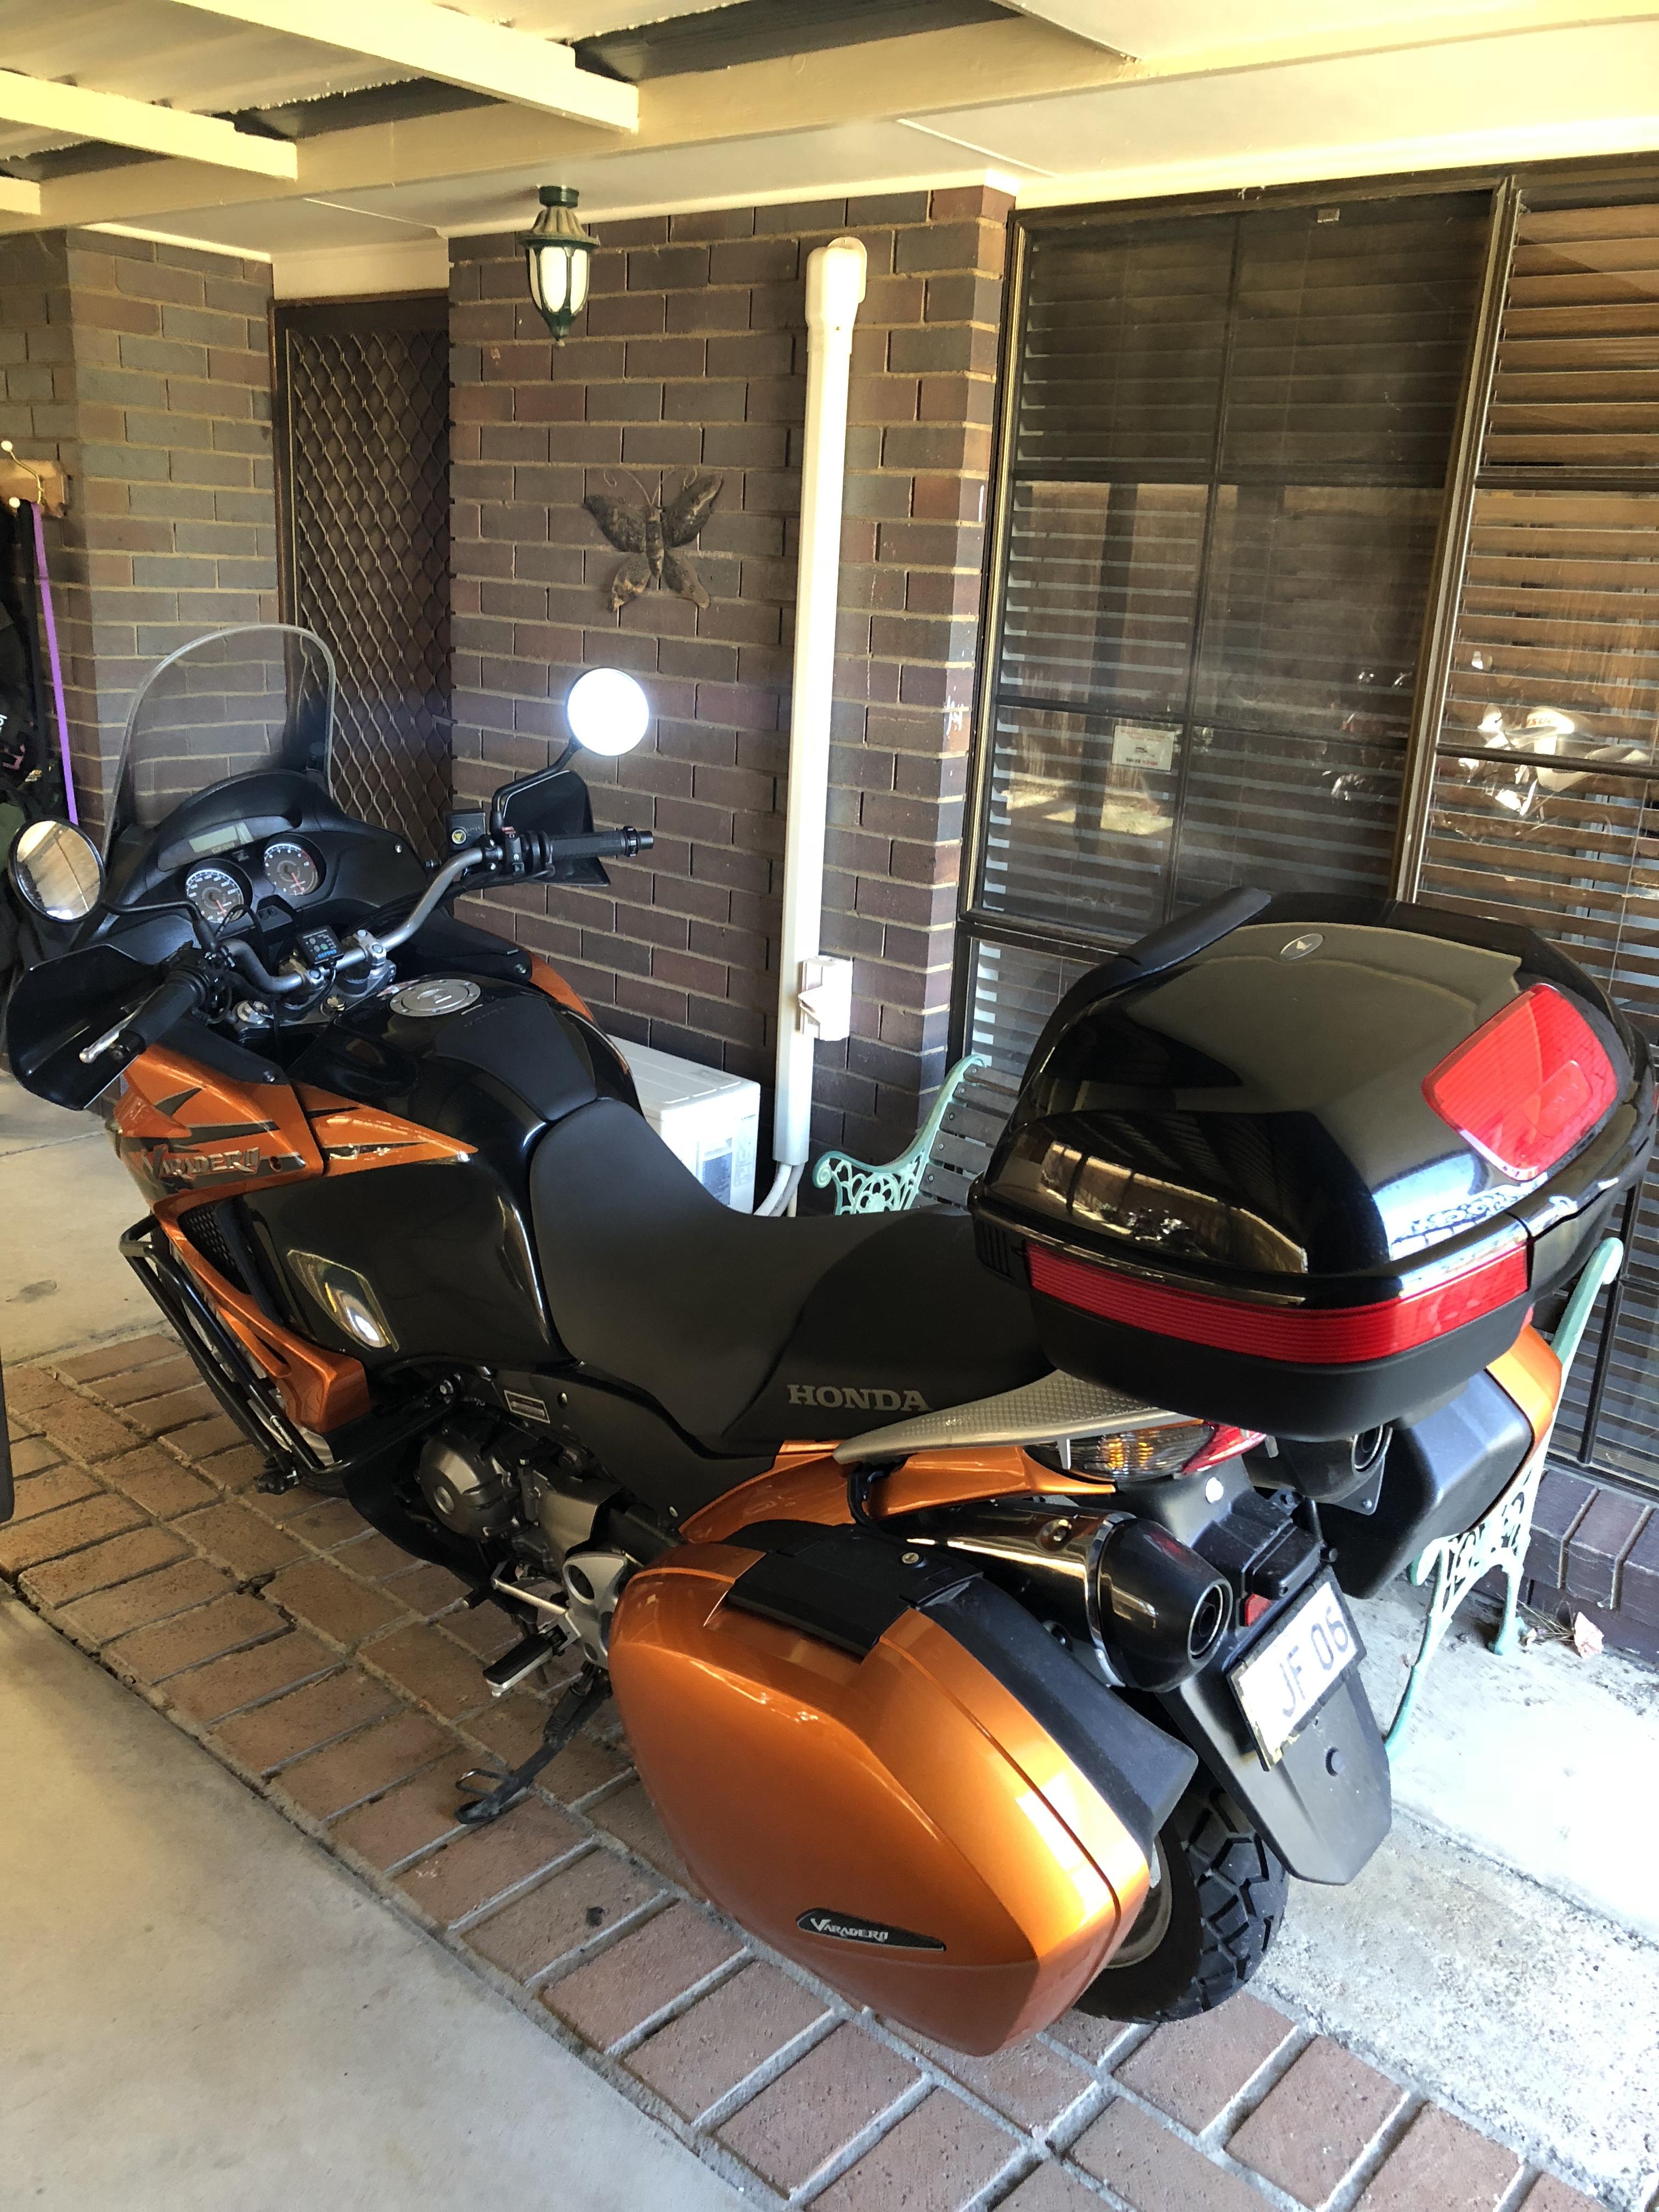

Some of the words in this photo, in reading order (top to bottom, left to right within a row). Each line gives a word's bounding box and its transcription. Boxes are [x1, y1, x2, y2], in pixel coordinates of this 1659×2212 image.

[787, 1384, 933, 1412] HONDA
[1279, 1645, 1306, 1718] JF
[1310, 1605, 1348, 1671] 06
